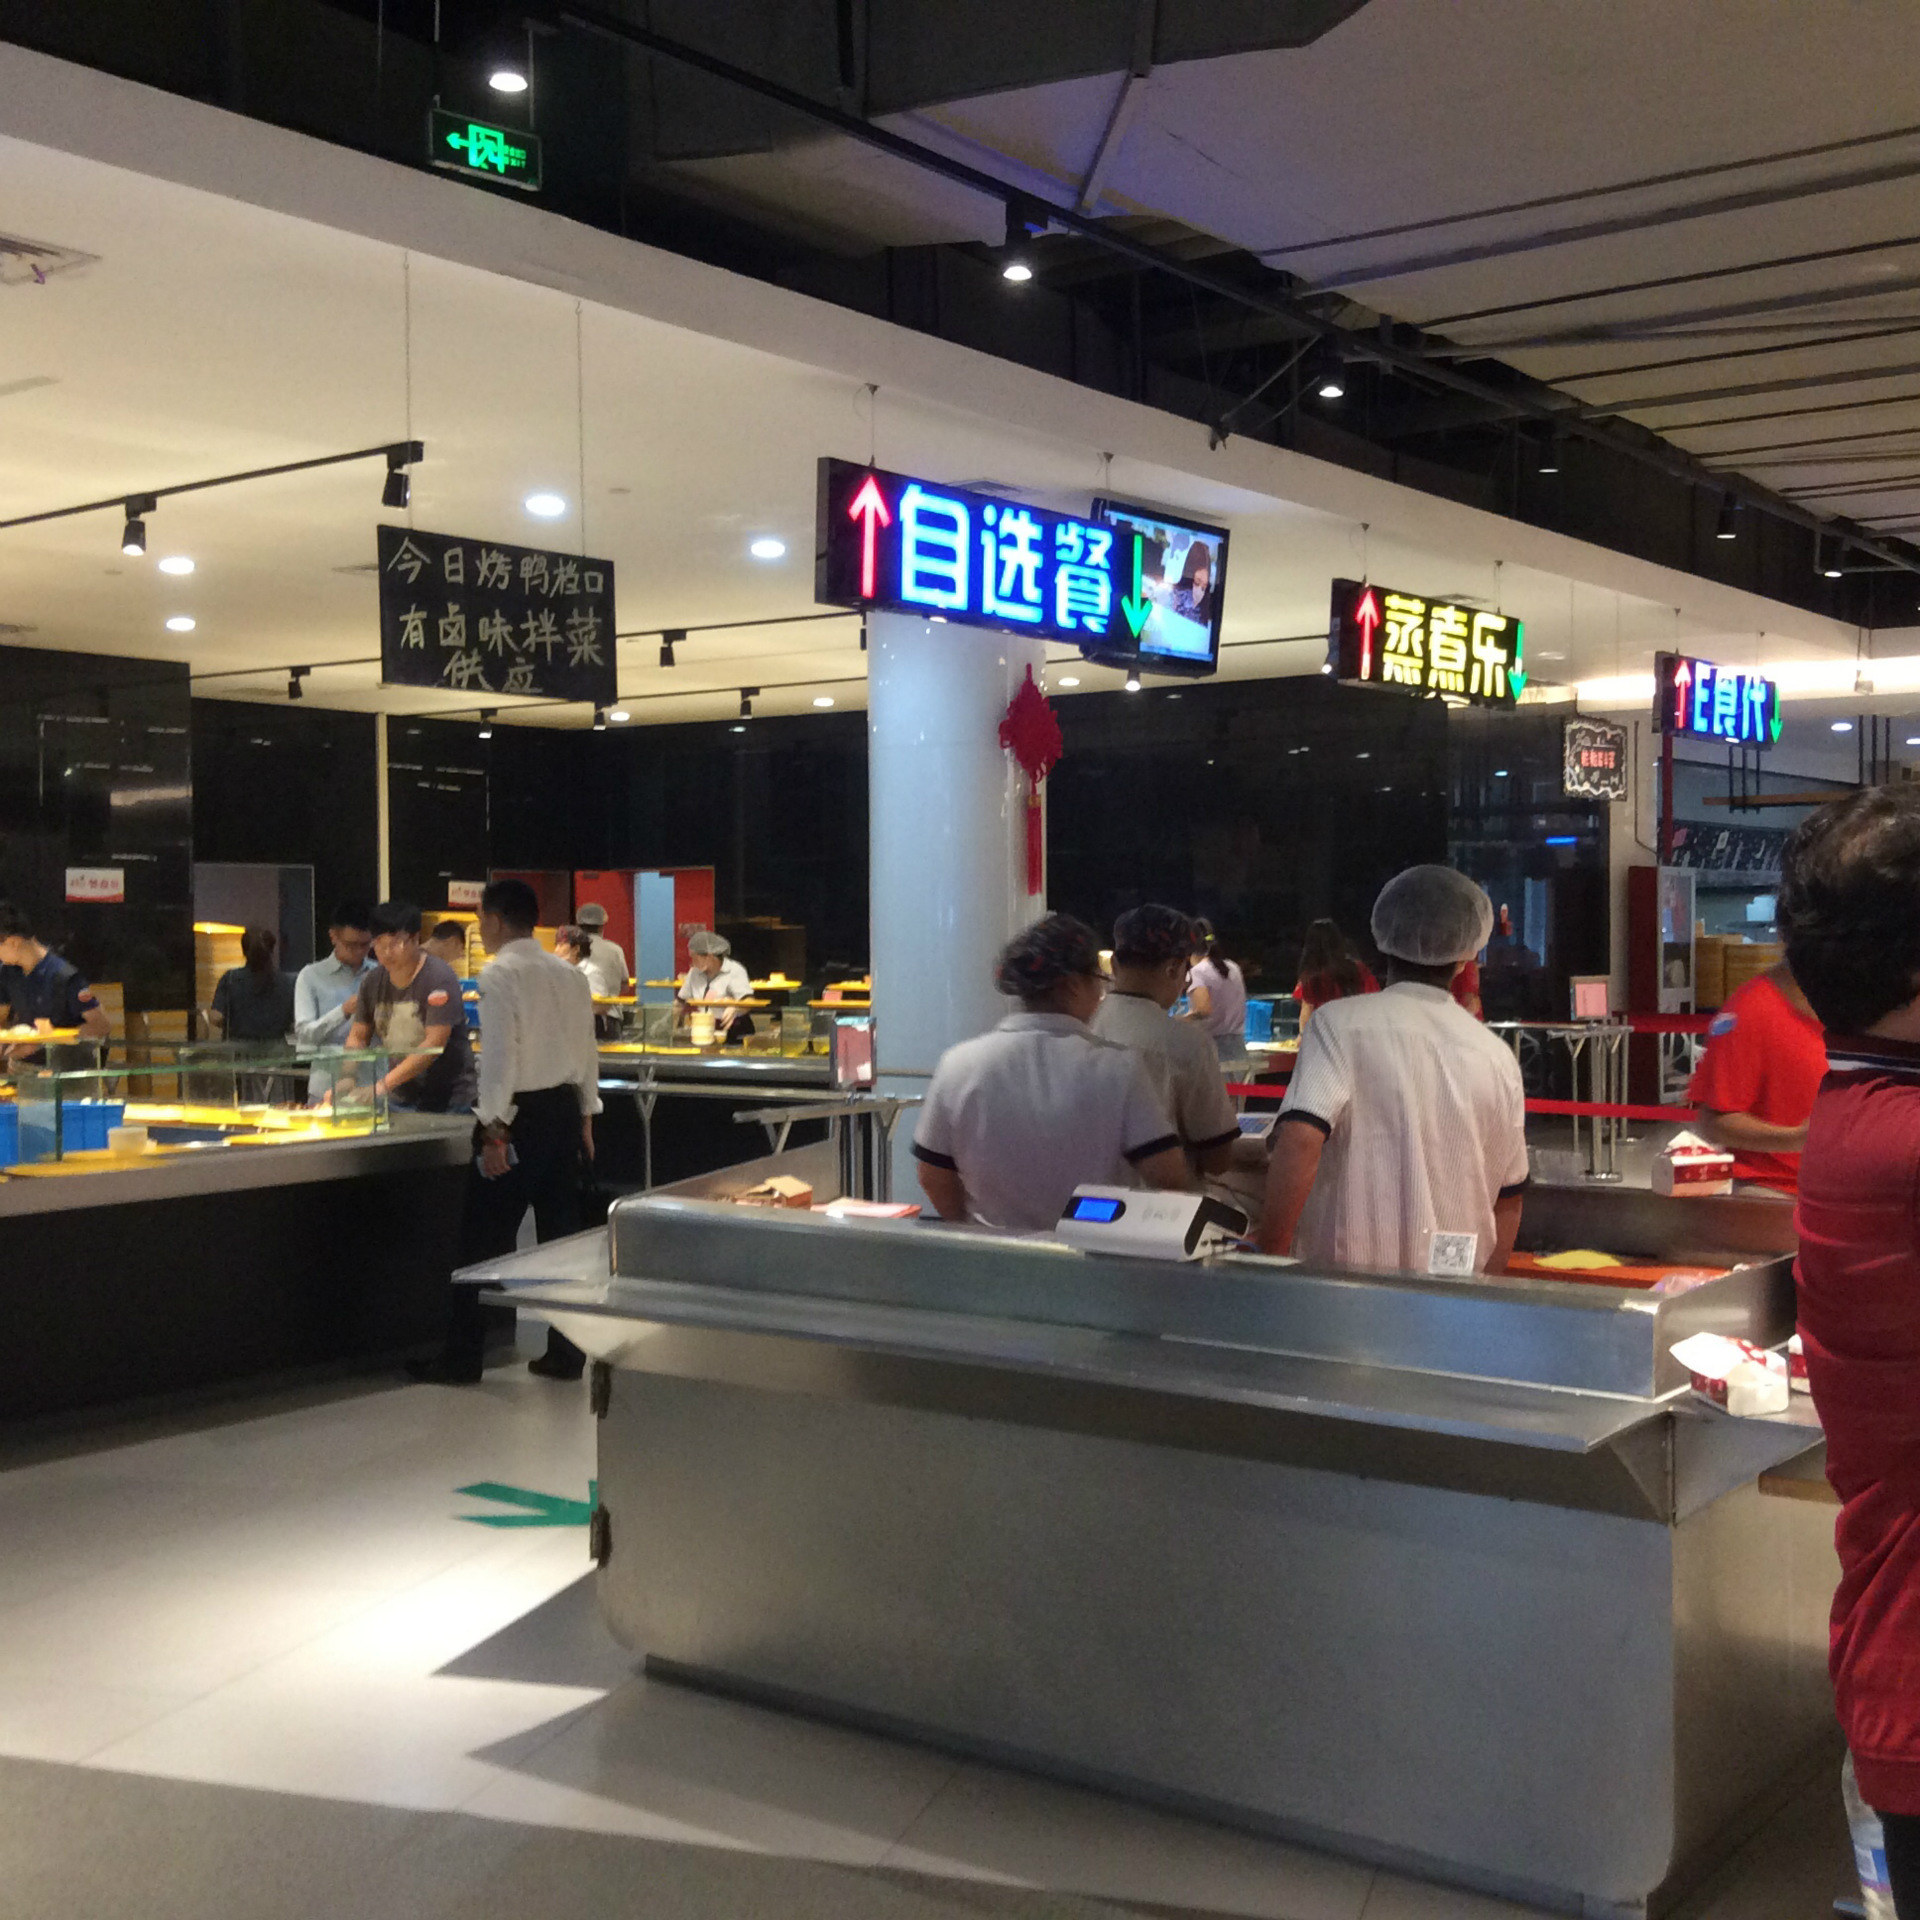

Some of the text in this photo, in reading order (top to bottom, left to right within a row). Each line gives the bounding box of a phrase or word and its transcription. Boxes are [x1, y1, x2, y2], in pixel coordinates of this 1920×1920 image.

[386, 536, 604, 598] 今日烤鸭档口
[899, 483, 1112, 634] 自选餐
[399, 601, 605, 667] 有卤味拌菜
[1382, 594, 1508, 698] 蒸煮乐
[442, 648, 544, 694] 供应
